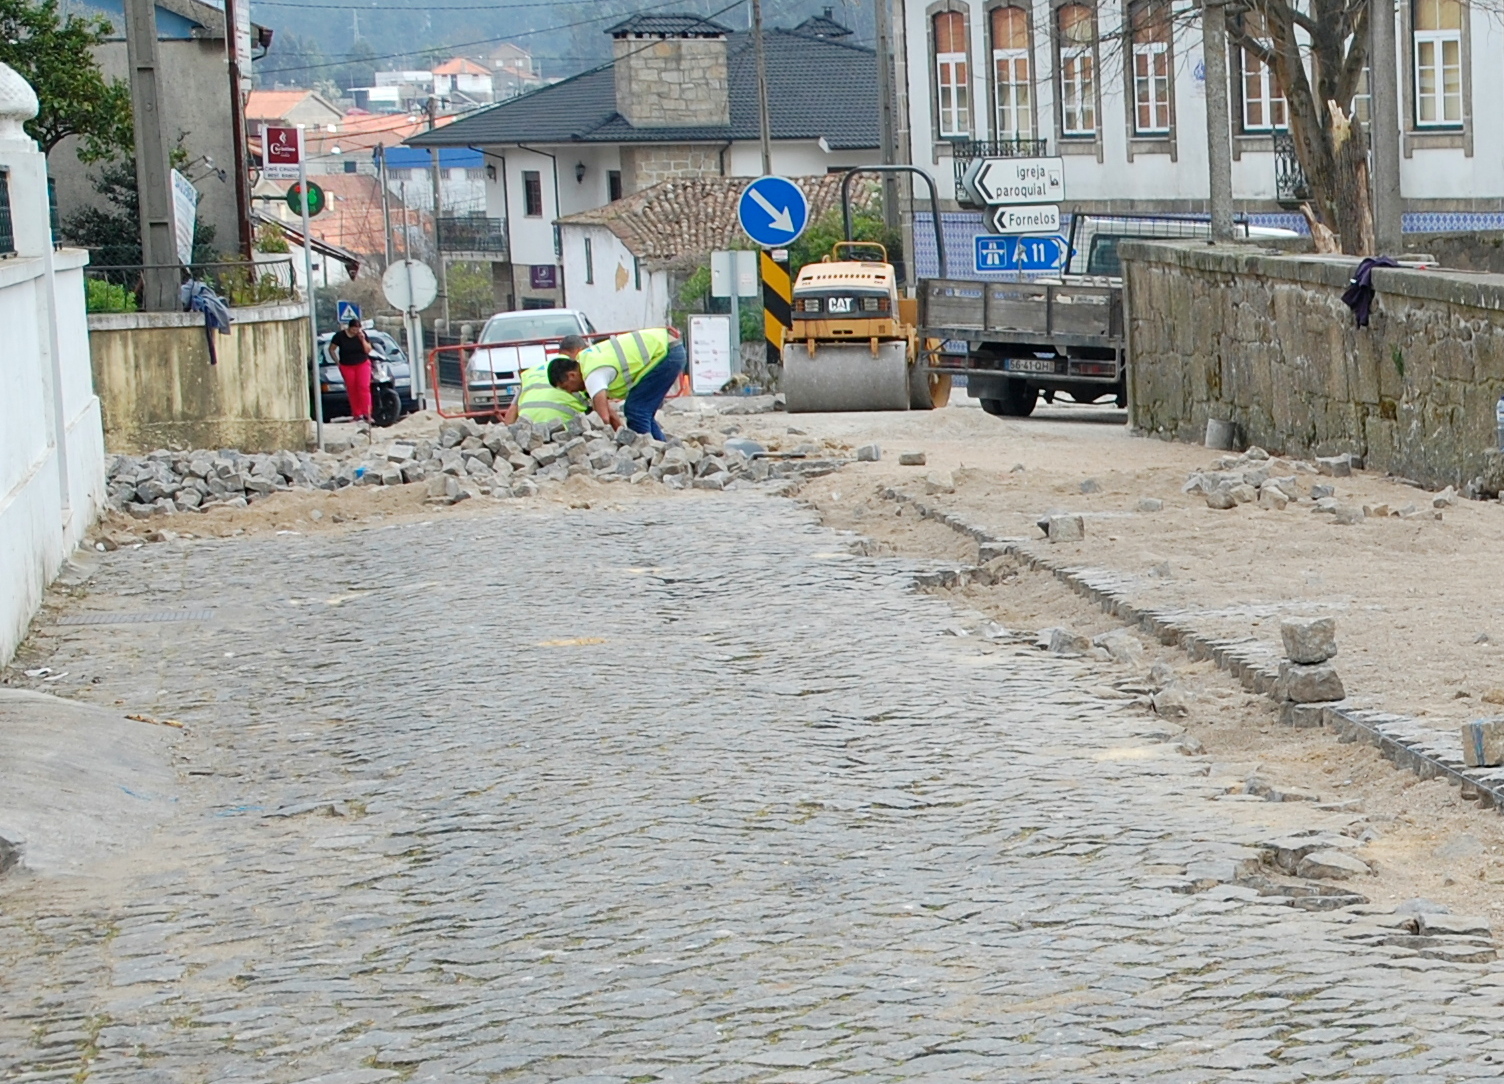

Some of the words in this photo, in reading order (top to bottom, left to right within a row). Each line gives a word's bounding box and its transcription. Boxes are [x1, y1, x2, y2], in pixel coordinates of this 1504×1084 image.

[996, 183, 1047, 199] paroquial
[1009, 212, 1056, 227] Fornelos
[1012, 243, 1028, 263] A
[1032, 243, 1045, 263] 11
[828, 297, 853, 312] CAT
